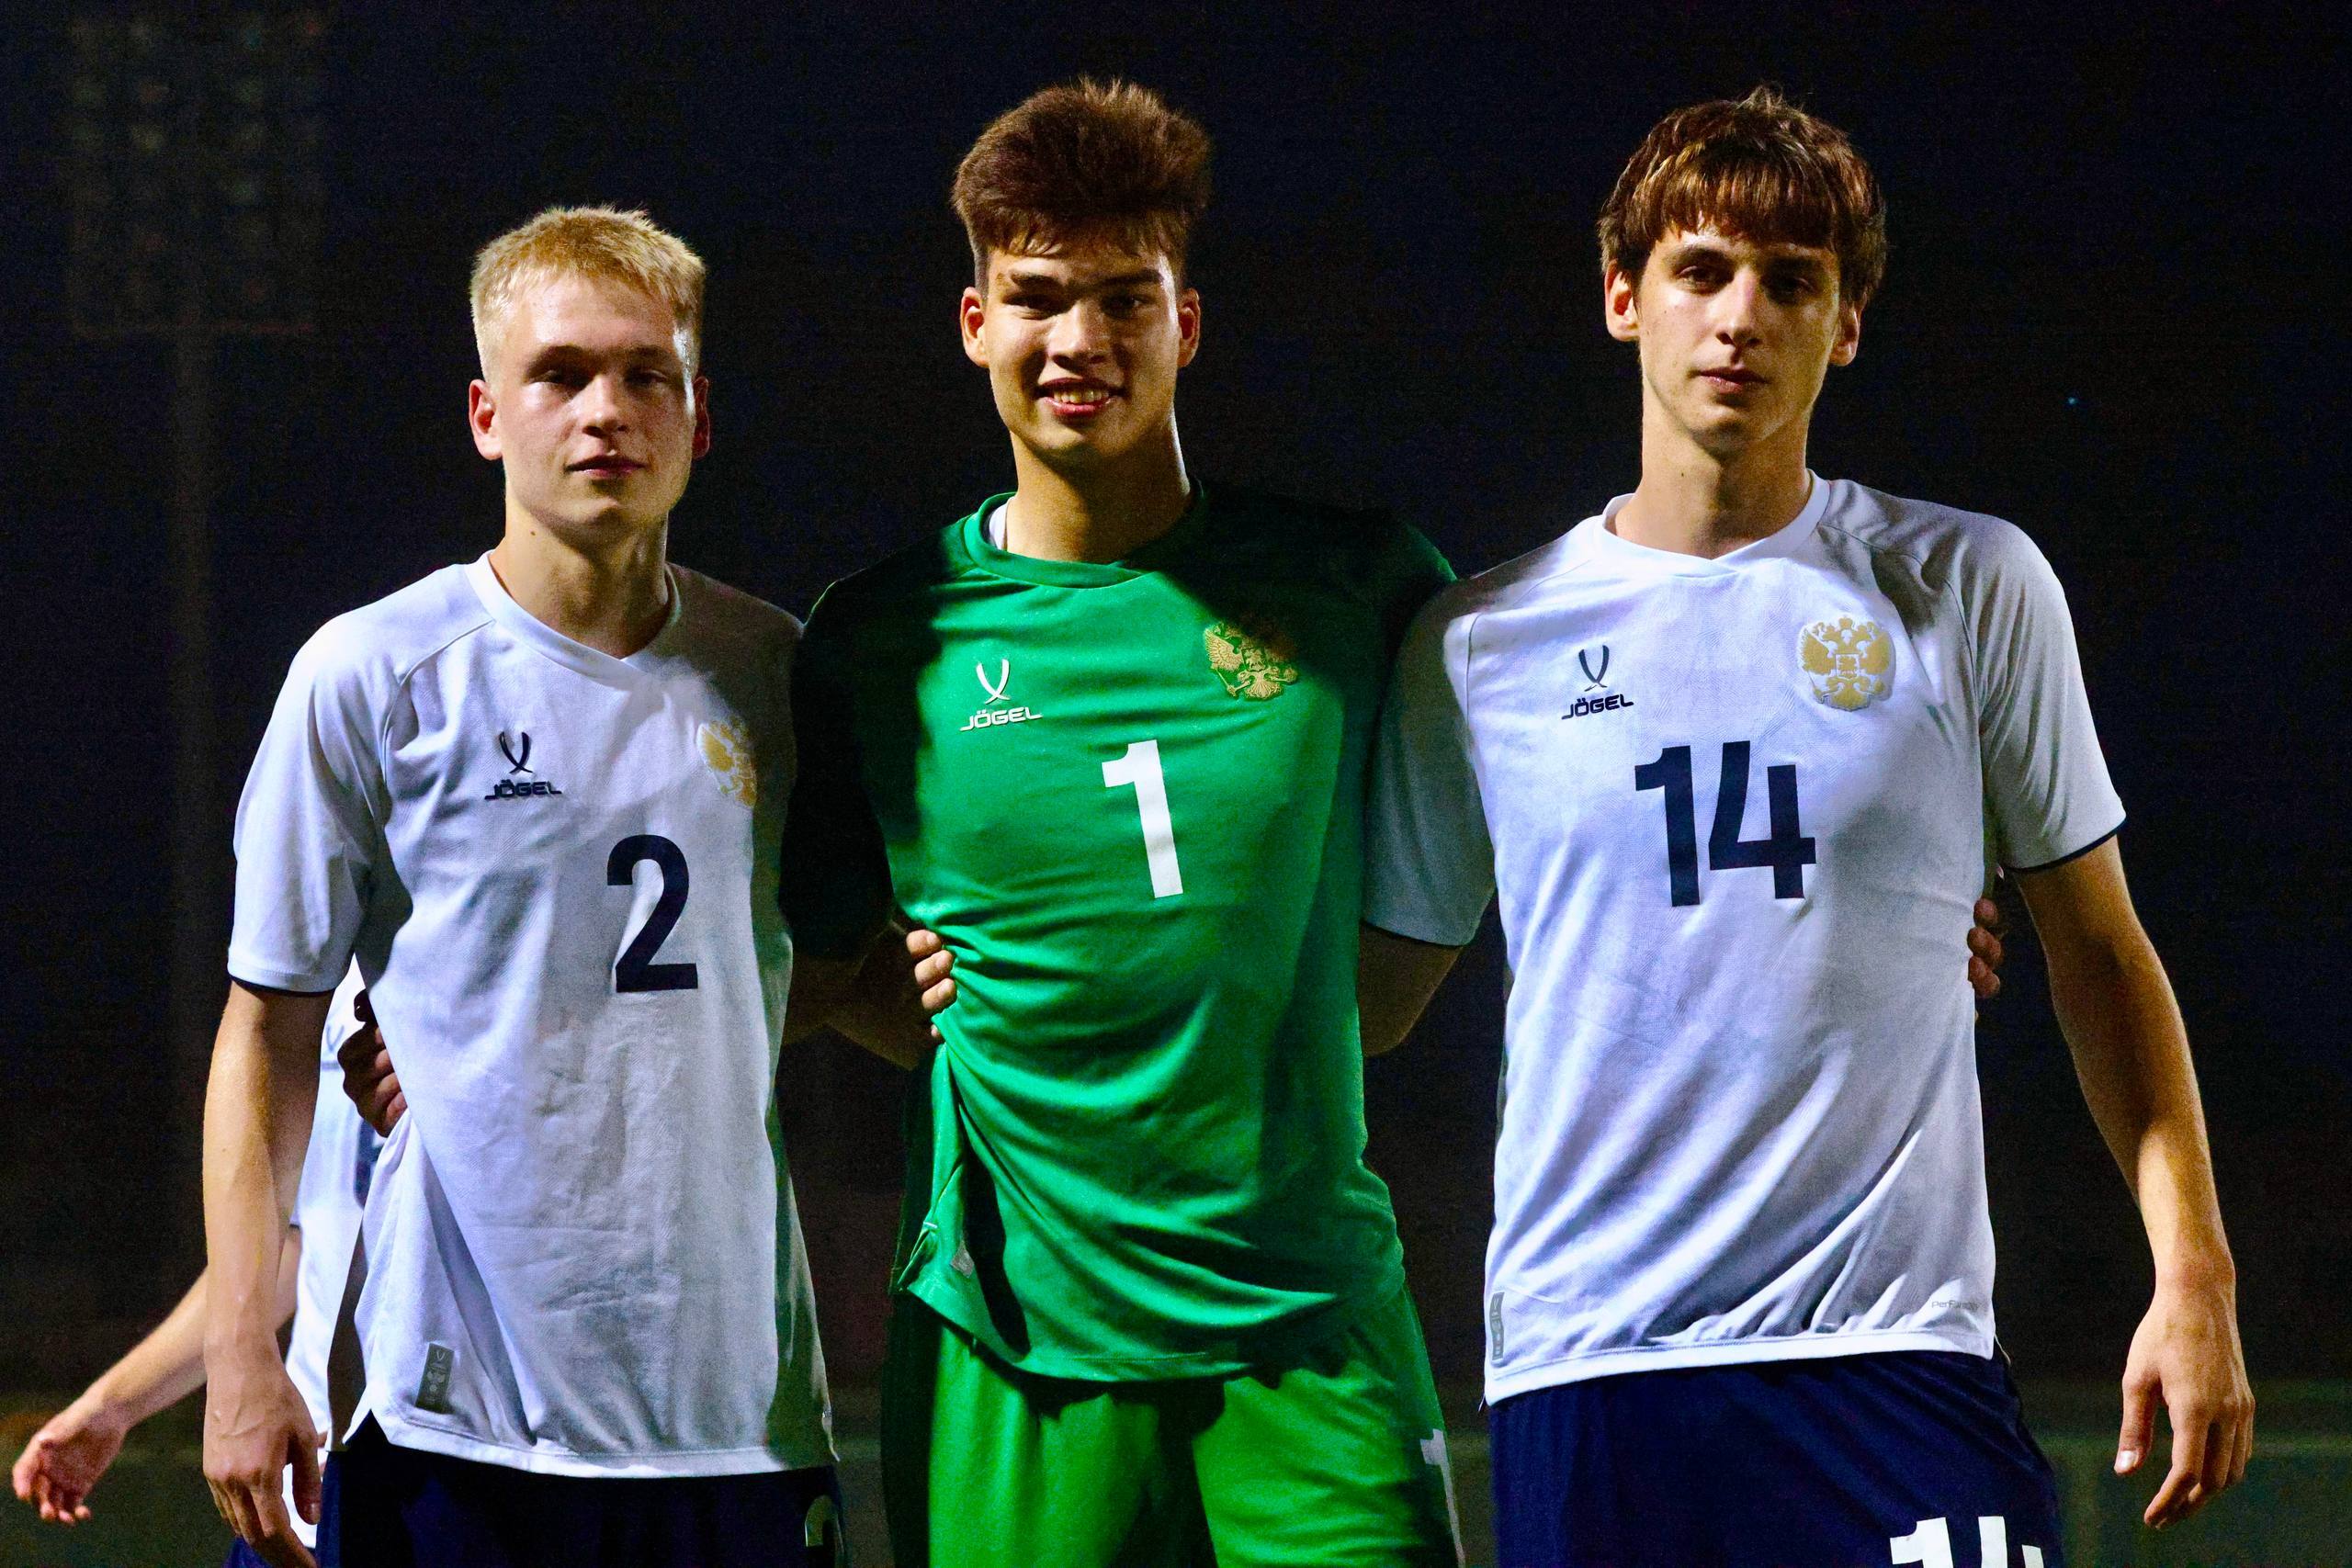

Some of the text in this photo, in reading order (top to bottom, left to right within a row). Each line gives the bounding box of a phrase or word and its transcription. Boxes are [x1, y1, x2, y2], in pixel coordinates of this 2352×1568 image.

[959, 706, 1043, 732] JÖGEL
[1561, 694, 1634, 720] JÖGEL
[484, 779, 562, 800] JÖGEL
[1102, 739, 1183, 898] 1
[1634, 740, 1816, 907] 14
[606, 834, 698, 993] 2
